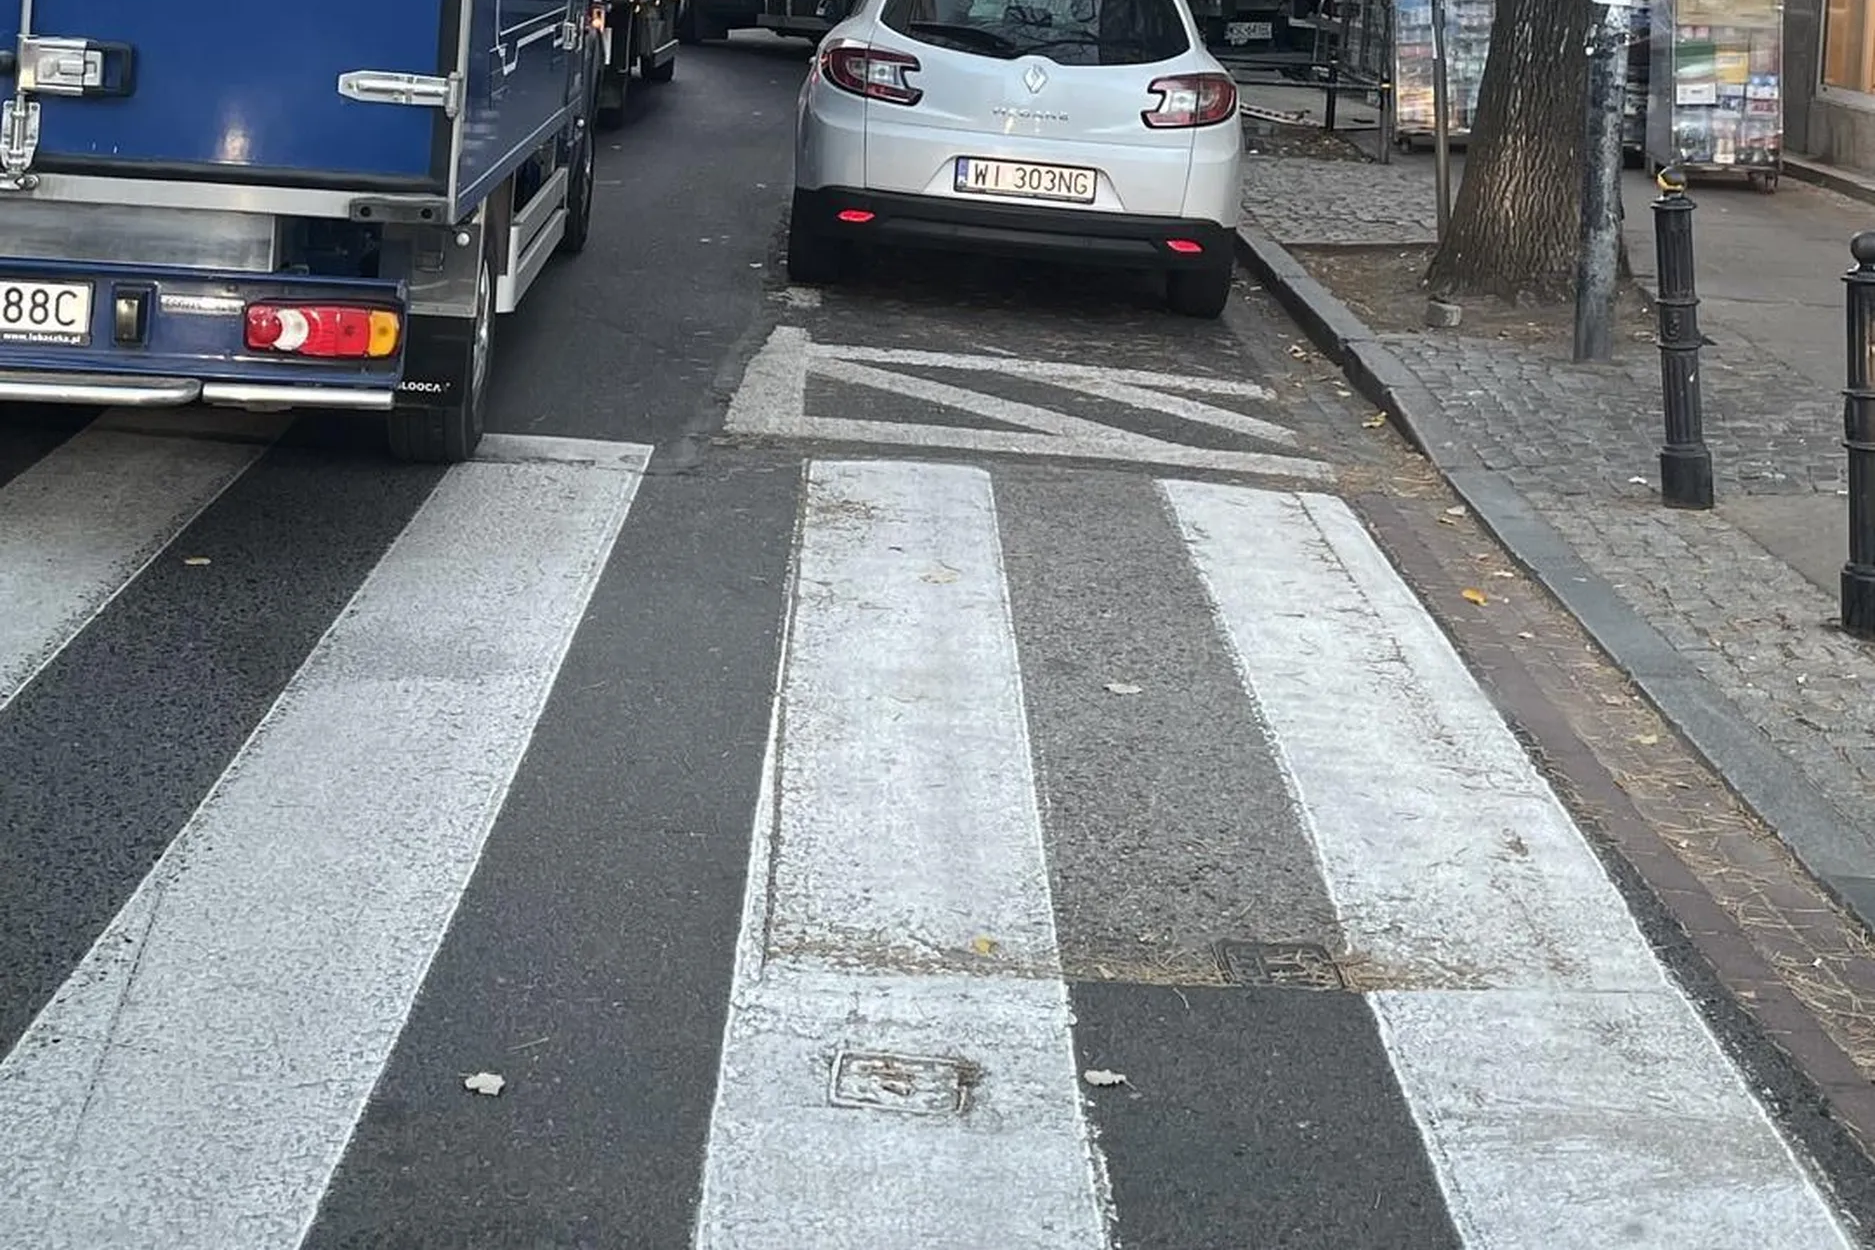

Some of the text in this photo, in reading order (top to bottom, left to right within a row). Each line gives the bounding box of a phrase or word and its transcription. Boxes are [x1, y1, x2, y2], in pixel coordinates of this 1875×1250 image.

[974, 163, 1088, 195] WI 303NG
[2, 286, 79, 327] 88C
[398, 381, 442, 393] LOOCA
